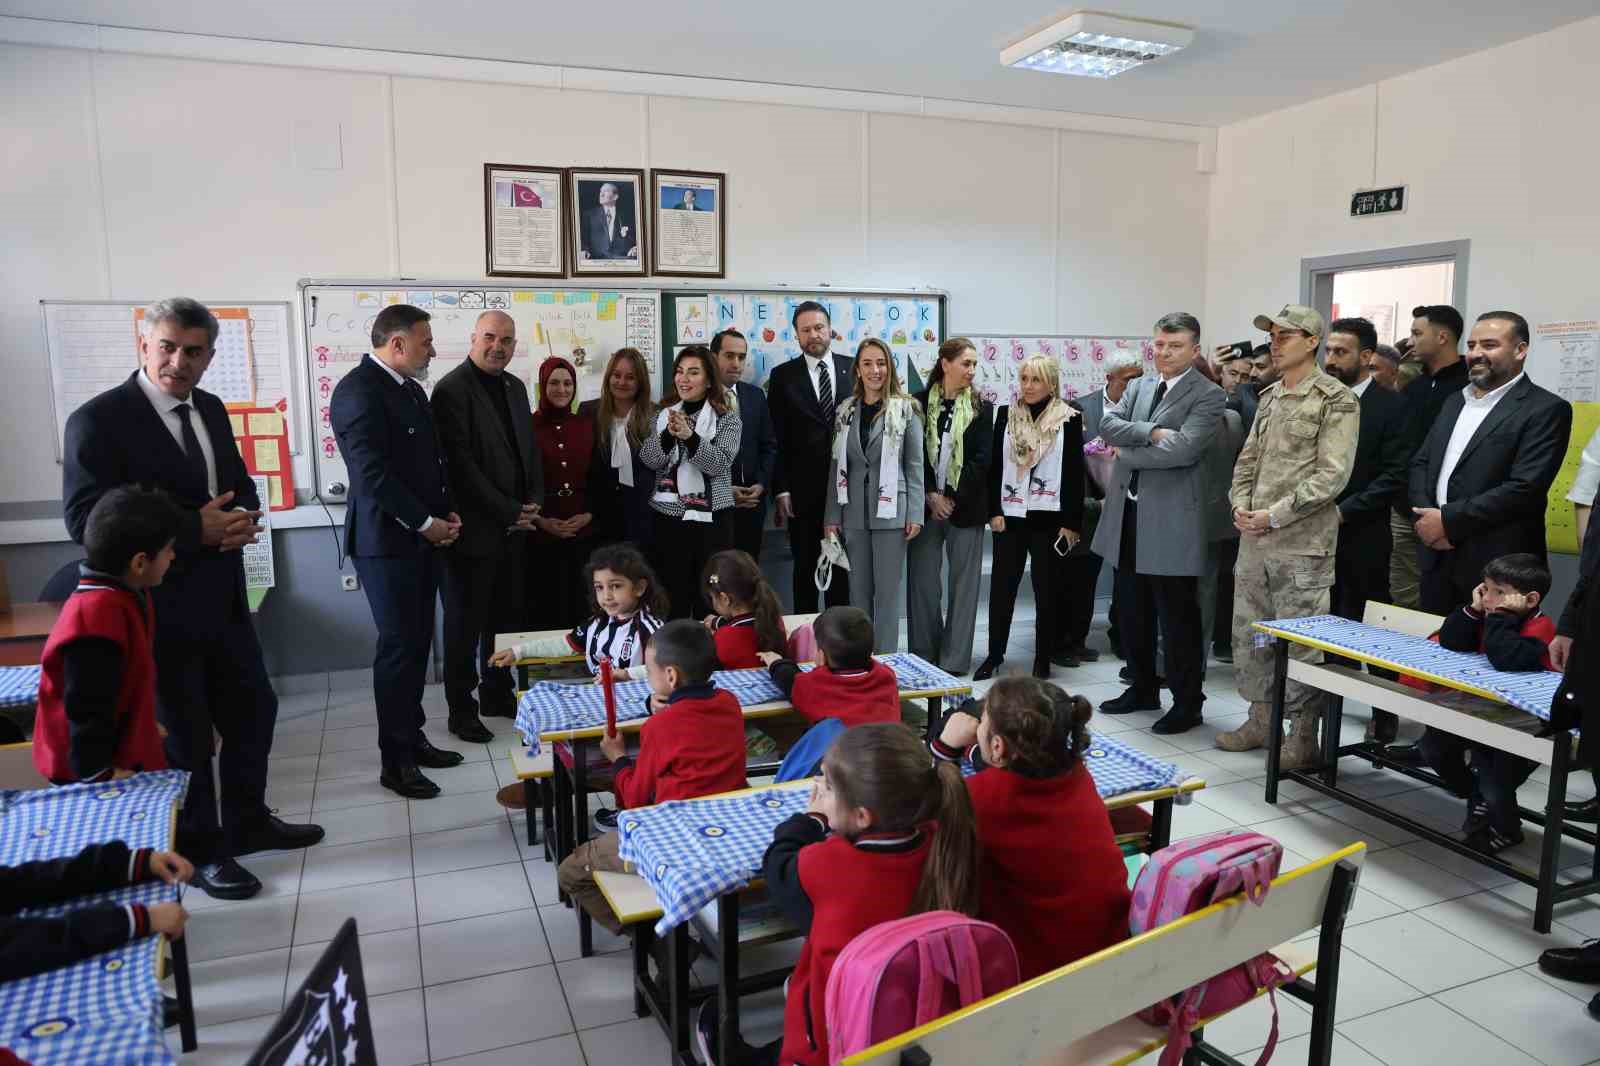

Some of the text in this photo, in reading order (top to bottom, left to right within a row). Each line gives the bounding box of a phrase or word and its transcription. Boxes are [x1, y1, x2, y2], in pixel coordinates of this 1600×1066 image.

[721, 304, 734, 321] N
[758, 304, 768, 320] E
[858, 306, 866, 321] L
[888, 306, 900, 321] O
[921, 306, 929, 321] K
[988, 346, 997, 361] 2
[1016, 346, 1025, 361] 3
[1071, 346, 1079, 361] 5
[1096, 347, 1104, 361] 6
